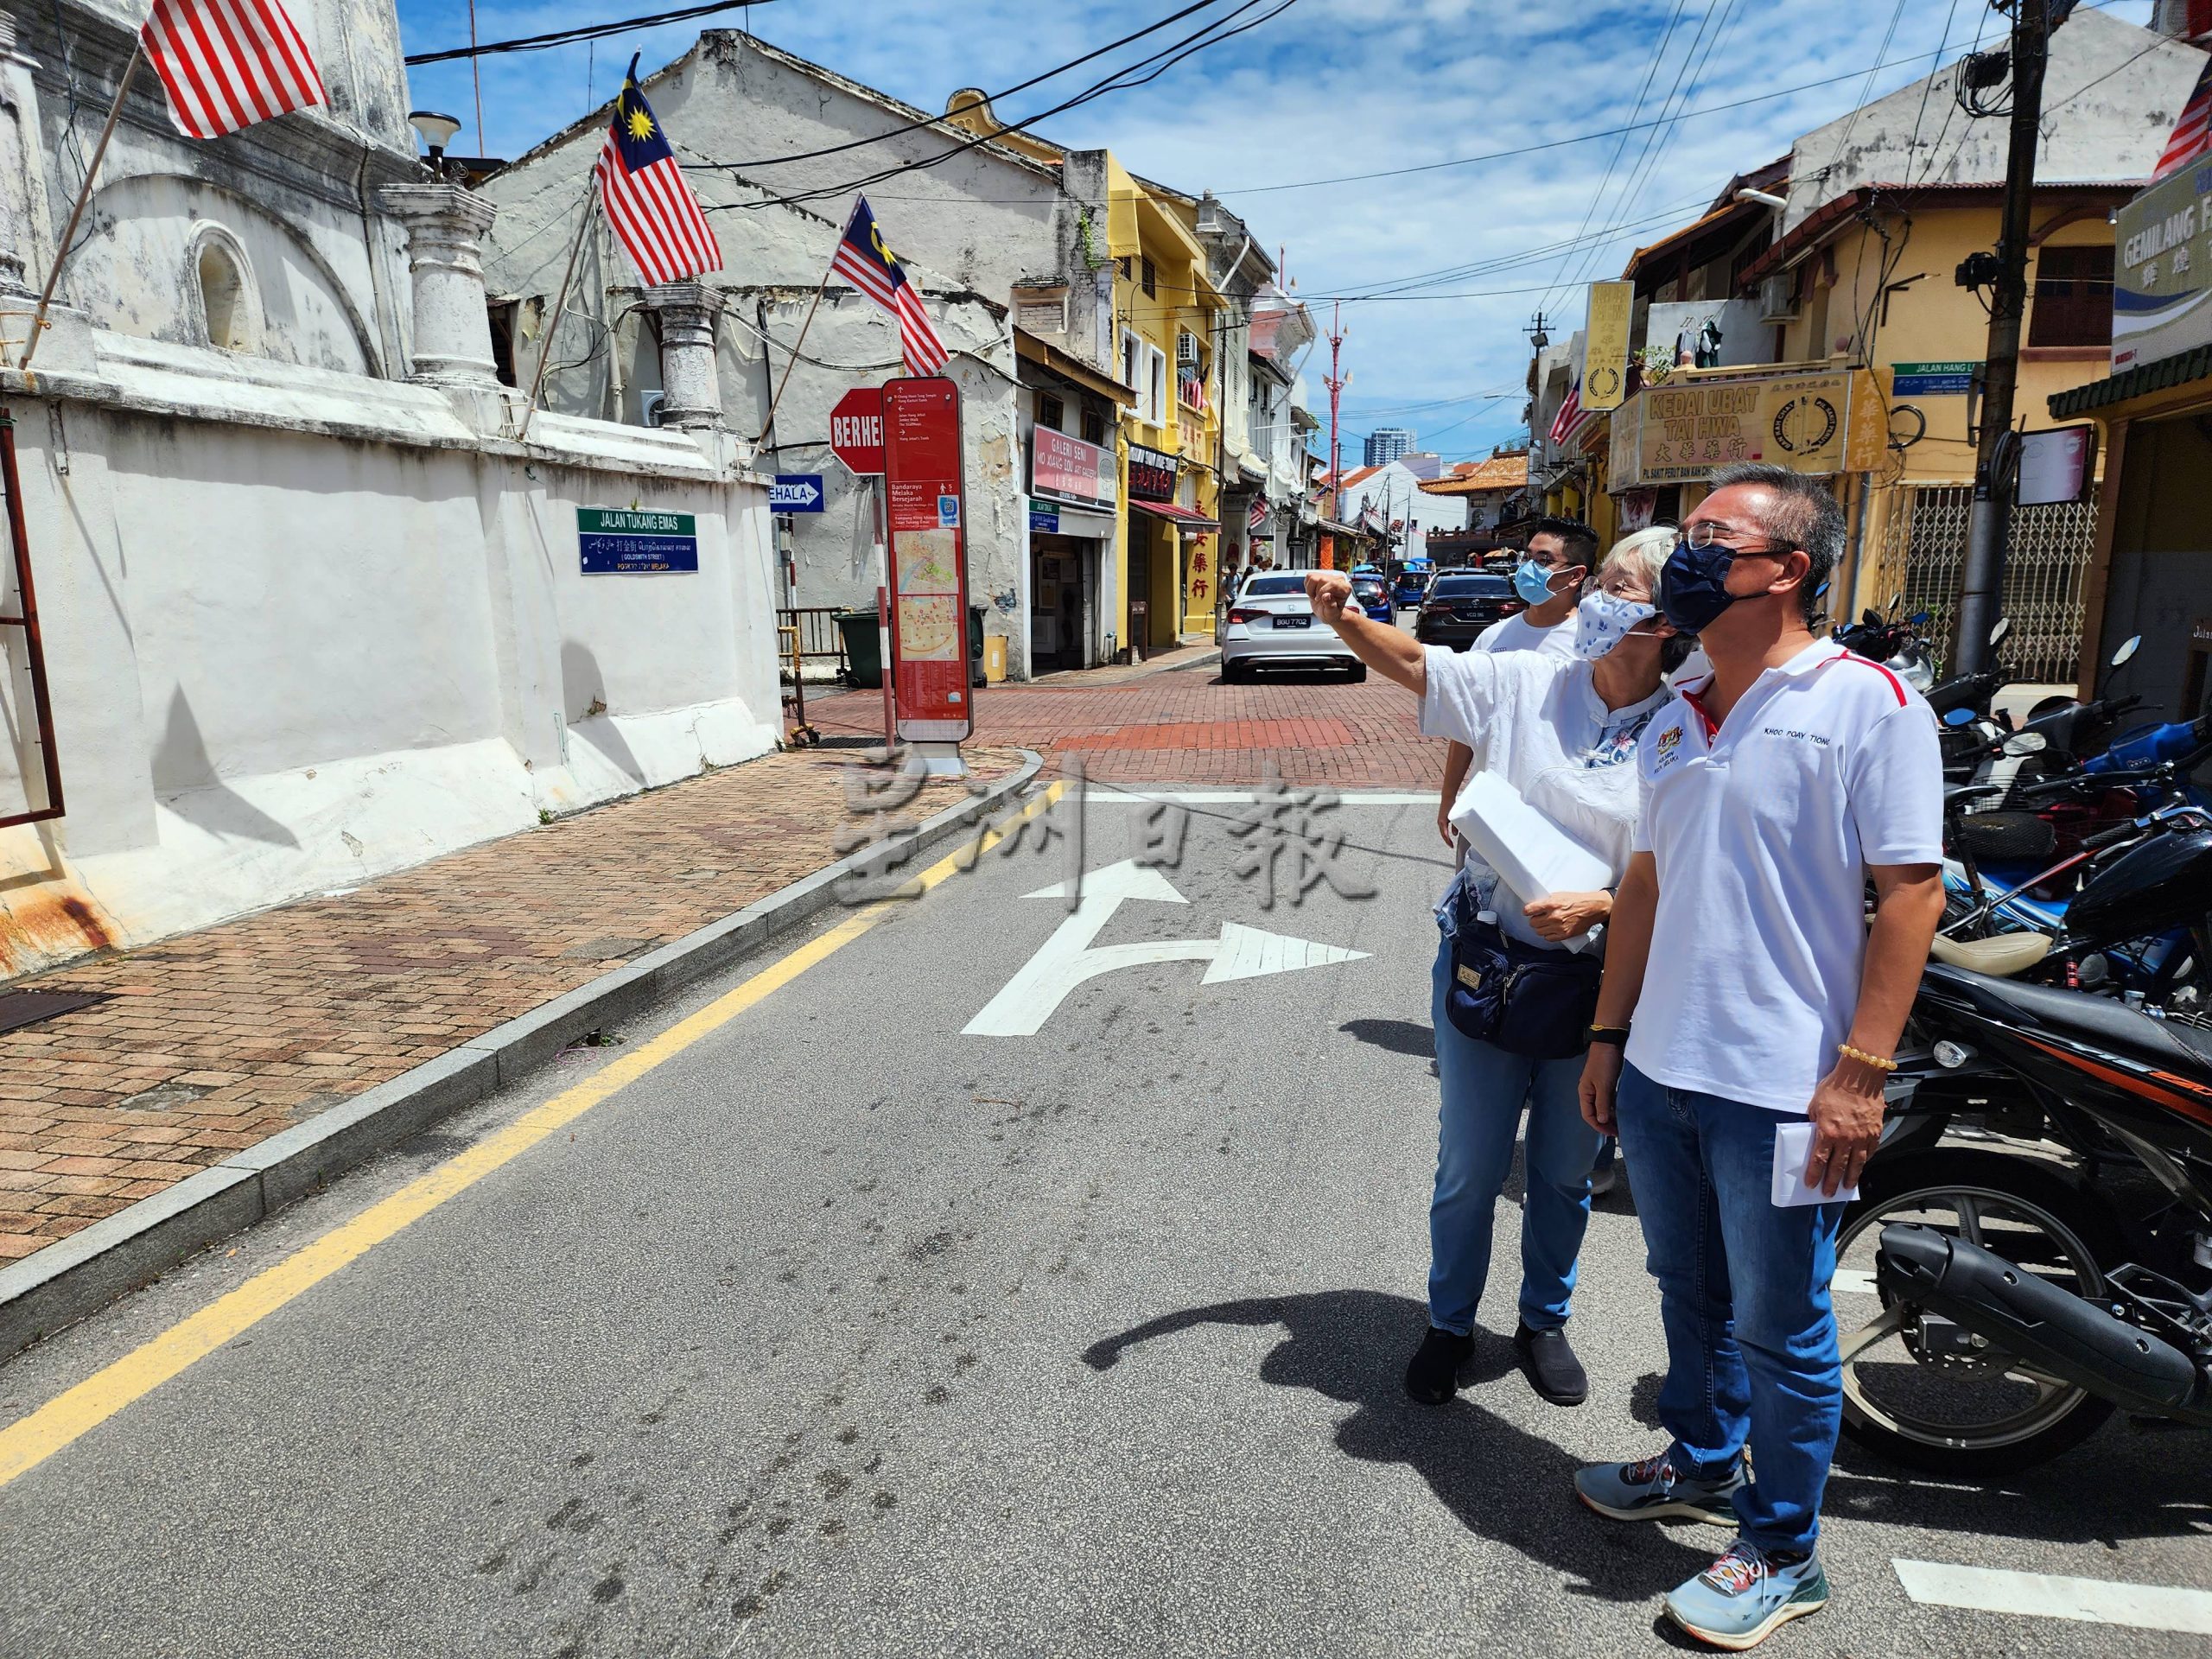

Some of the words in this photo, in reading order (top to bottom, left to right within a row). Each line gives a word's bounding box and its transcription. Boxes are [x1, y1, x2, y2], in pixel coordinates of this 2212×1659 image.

[2124, 205, 2195, 269] GEMILANG
[1917, 364, 1942, 372] JALAN
[1942, 364, 1966, 372] HANG
[1650, 391, 1704, 420] KEDAI
[1707, 386, 1761, 415] UBAT
[1777, 401, 1795, 419] CHAT
[833, 416, 884, 448] BERHE
[1664, 419, 1694, 442] TAI
[1698, 416, 1741, 440] HWA
[1052, 438, 1072, 457] GALERI
[1074, 446, 1086, 461] SENI
[1037, 451, 1046, 465] MO
[1046, 454, 1062, 470] XIANG
[601, 512, 626, 528] JALAN
[626, 513, 657, 530] TUKANG
[658, 515, 678, 530] EMAS
[617, 539, 637, 552] 打金街
[1764, 728, 1783, 736] KHOO
[1786, 730, 1806, 740] POAY
